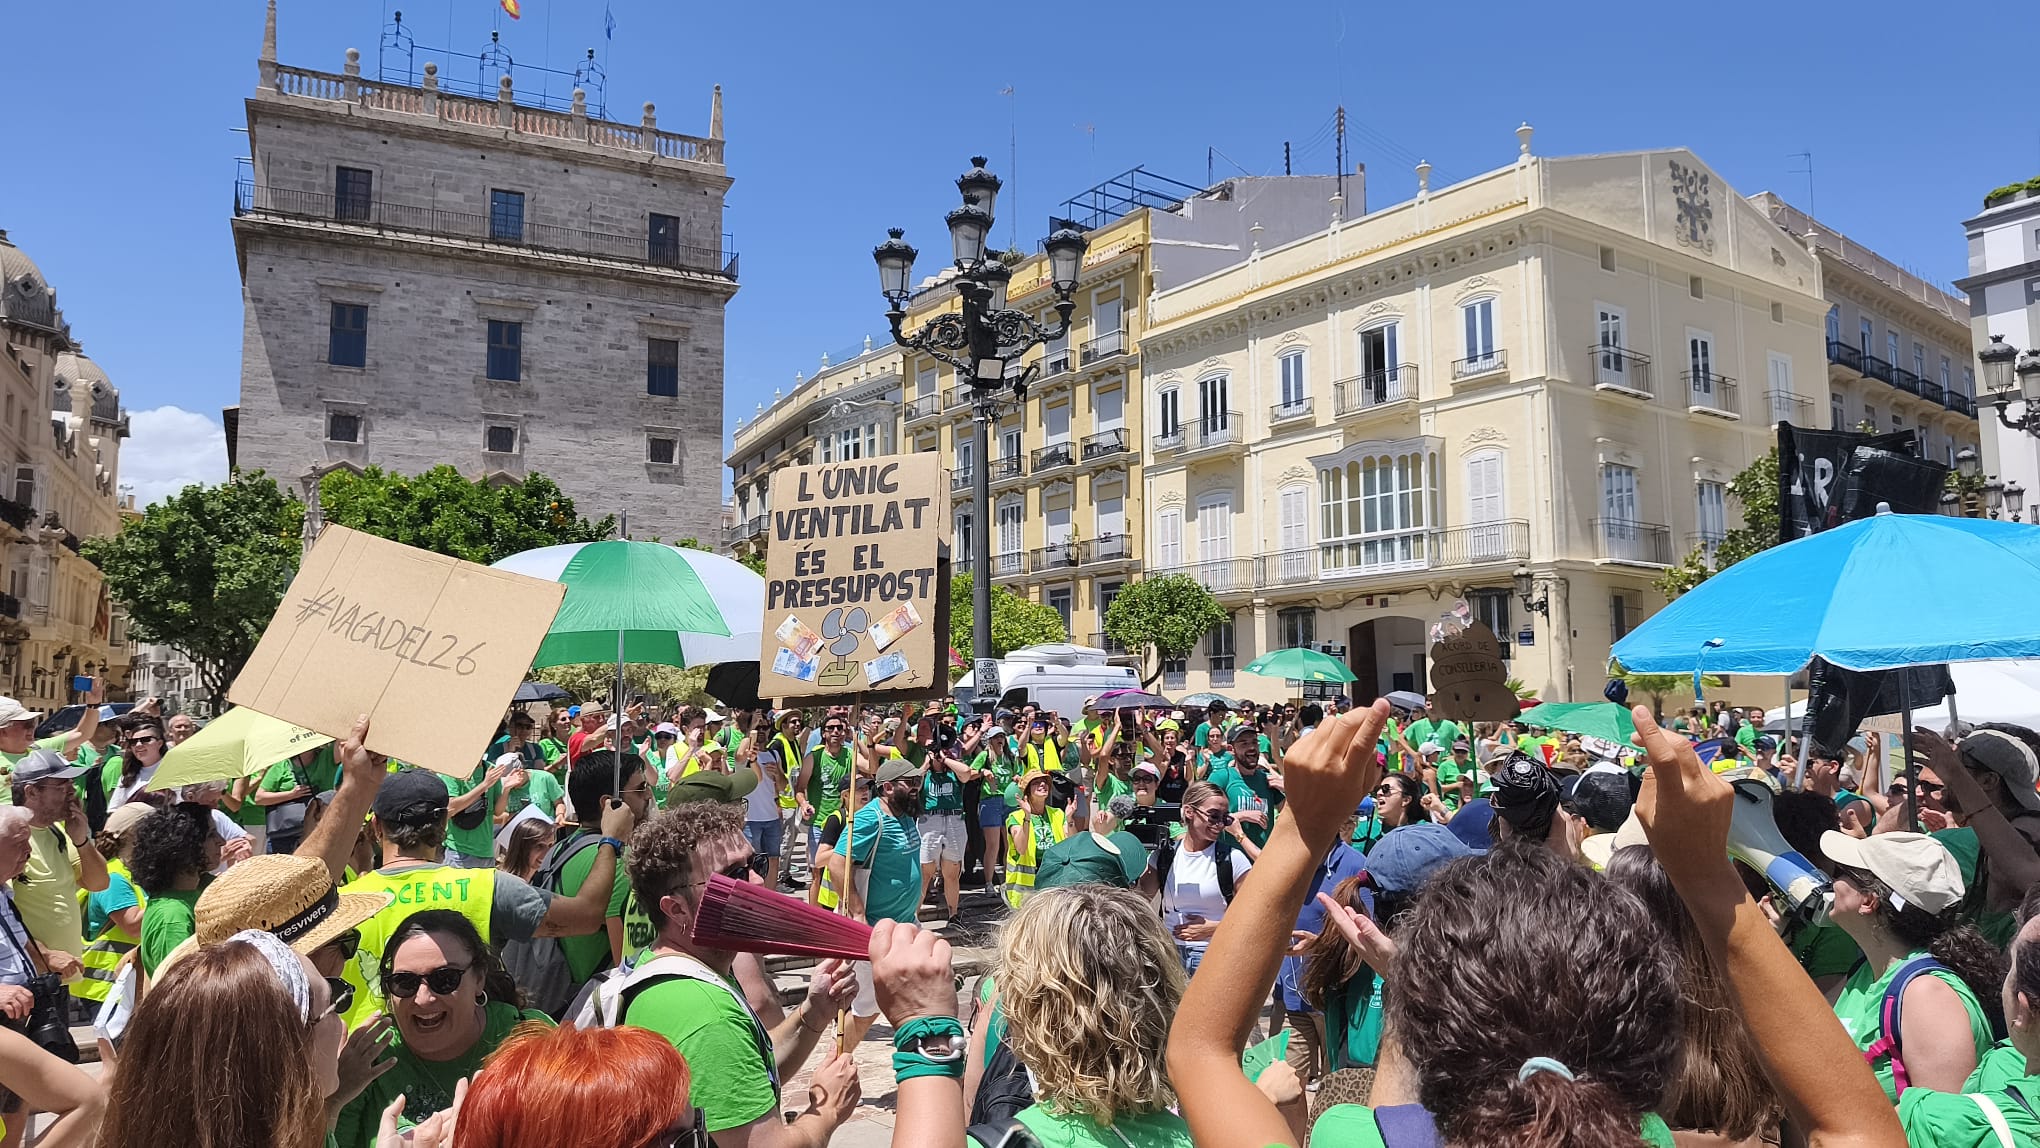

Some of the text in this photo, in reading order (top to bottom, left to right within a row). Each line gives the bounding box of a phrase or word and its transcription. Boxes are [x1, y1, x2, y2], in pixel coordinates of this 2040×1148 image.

[797, 462, 899, 502] L'ÚNIC
[775, 497, 931, 541] VENTILAT
[795, 542, 884, 577] ÉS EL
[768, 567, 934, 610] PRESSUPOST
[295, 587, 487, 676] #VAGADEL26
